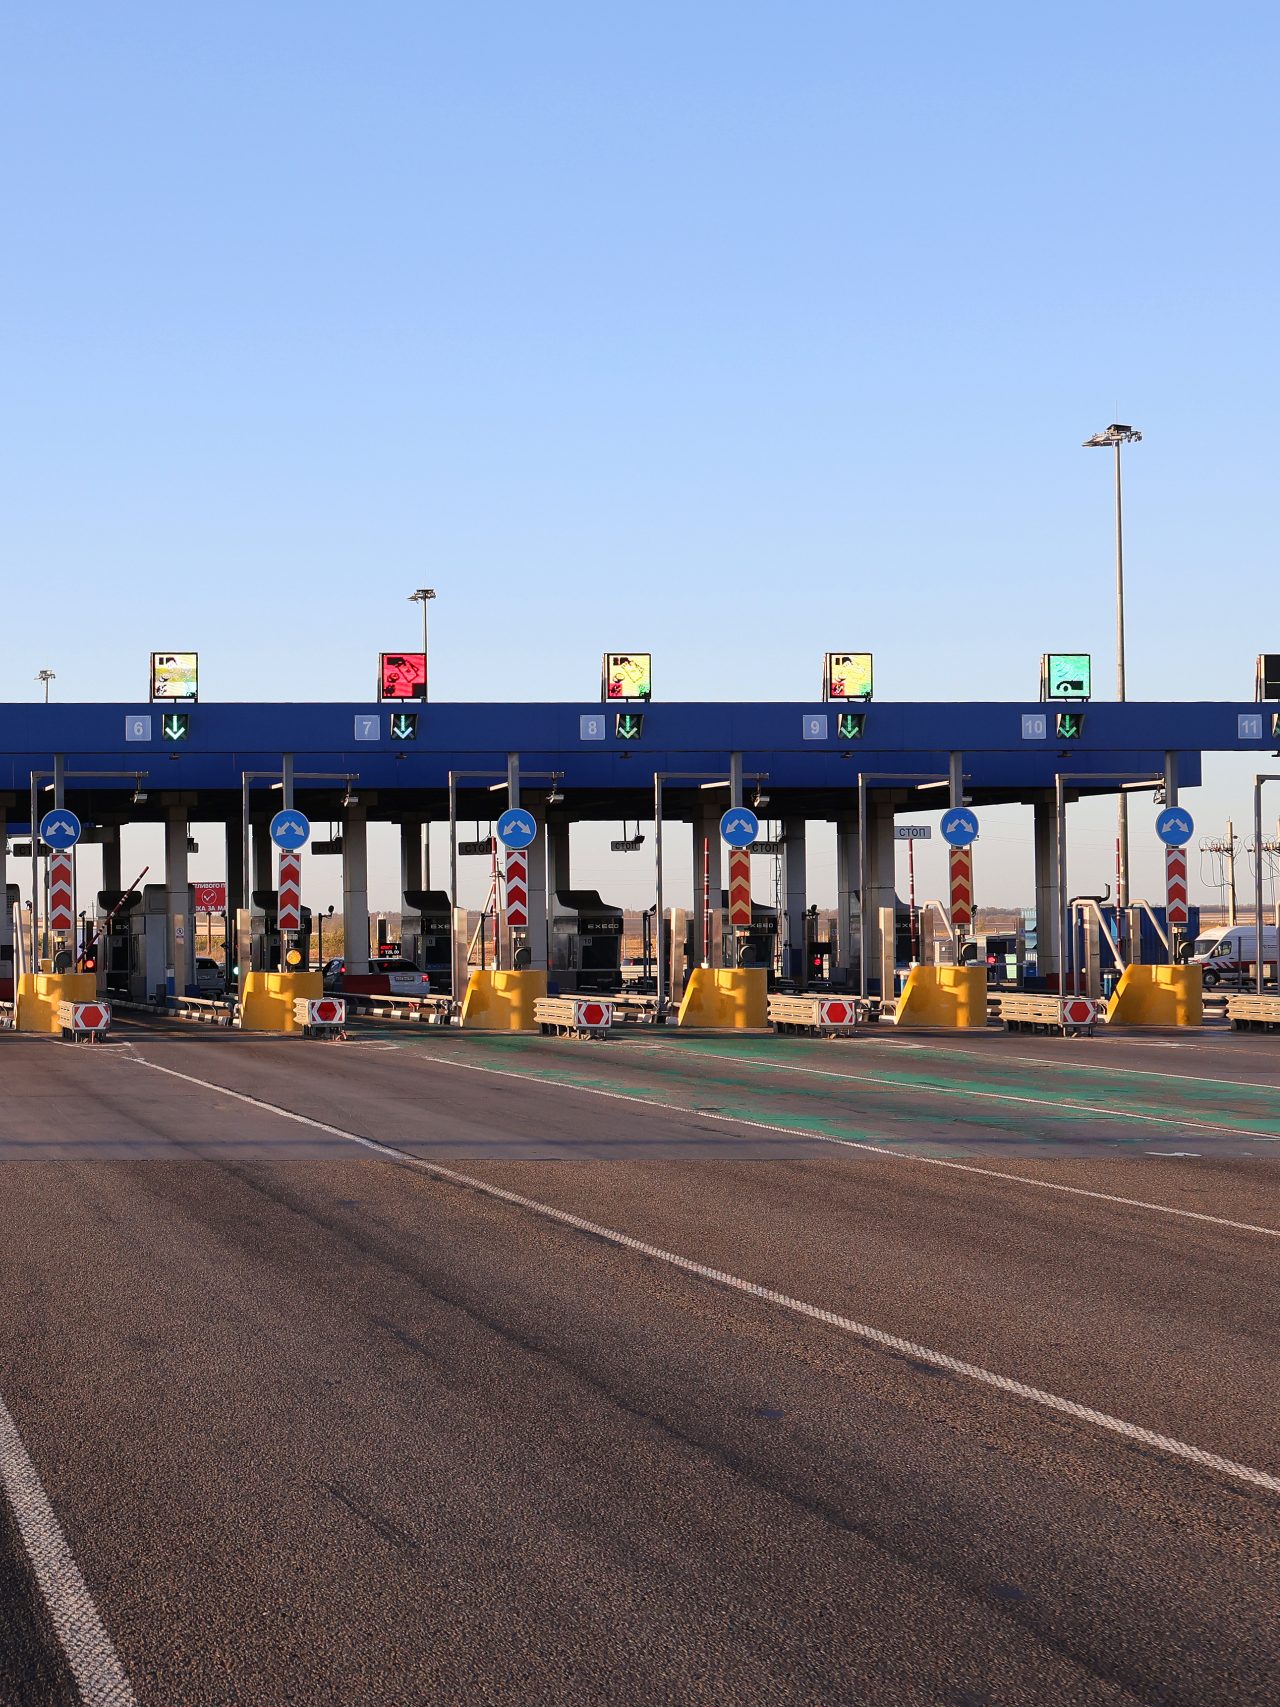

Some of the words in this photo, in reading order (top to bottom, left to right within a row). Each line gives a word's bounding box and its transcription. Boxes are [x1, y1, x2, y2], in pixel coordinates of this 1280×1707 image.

[133, 721, 143, 736] 6
[362, 721, 372, 736] 7
[588, 720, 597, 735] 8
[810, 720, 820, 734] 9
[1025, 720, 1042, 734] 10
[1242, 720, 1257, 734] 11
[899, 828, 926, 837] СТОП
[20, 846, 47, 855] СТП
[616, 842, 637, 850] СТОП
[752, 844, 779, 853] СТОП
